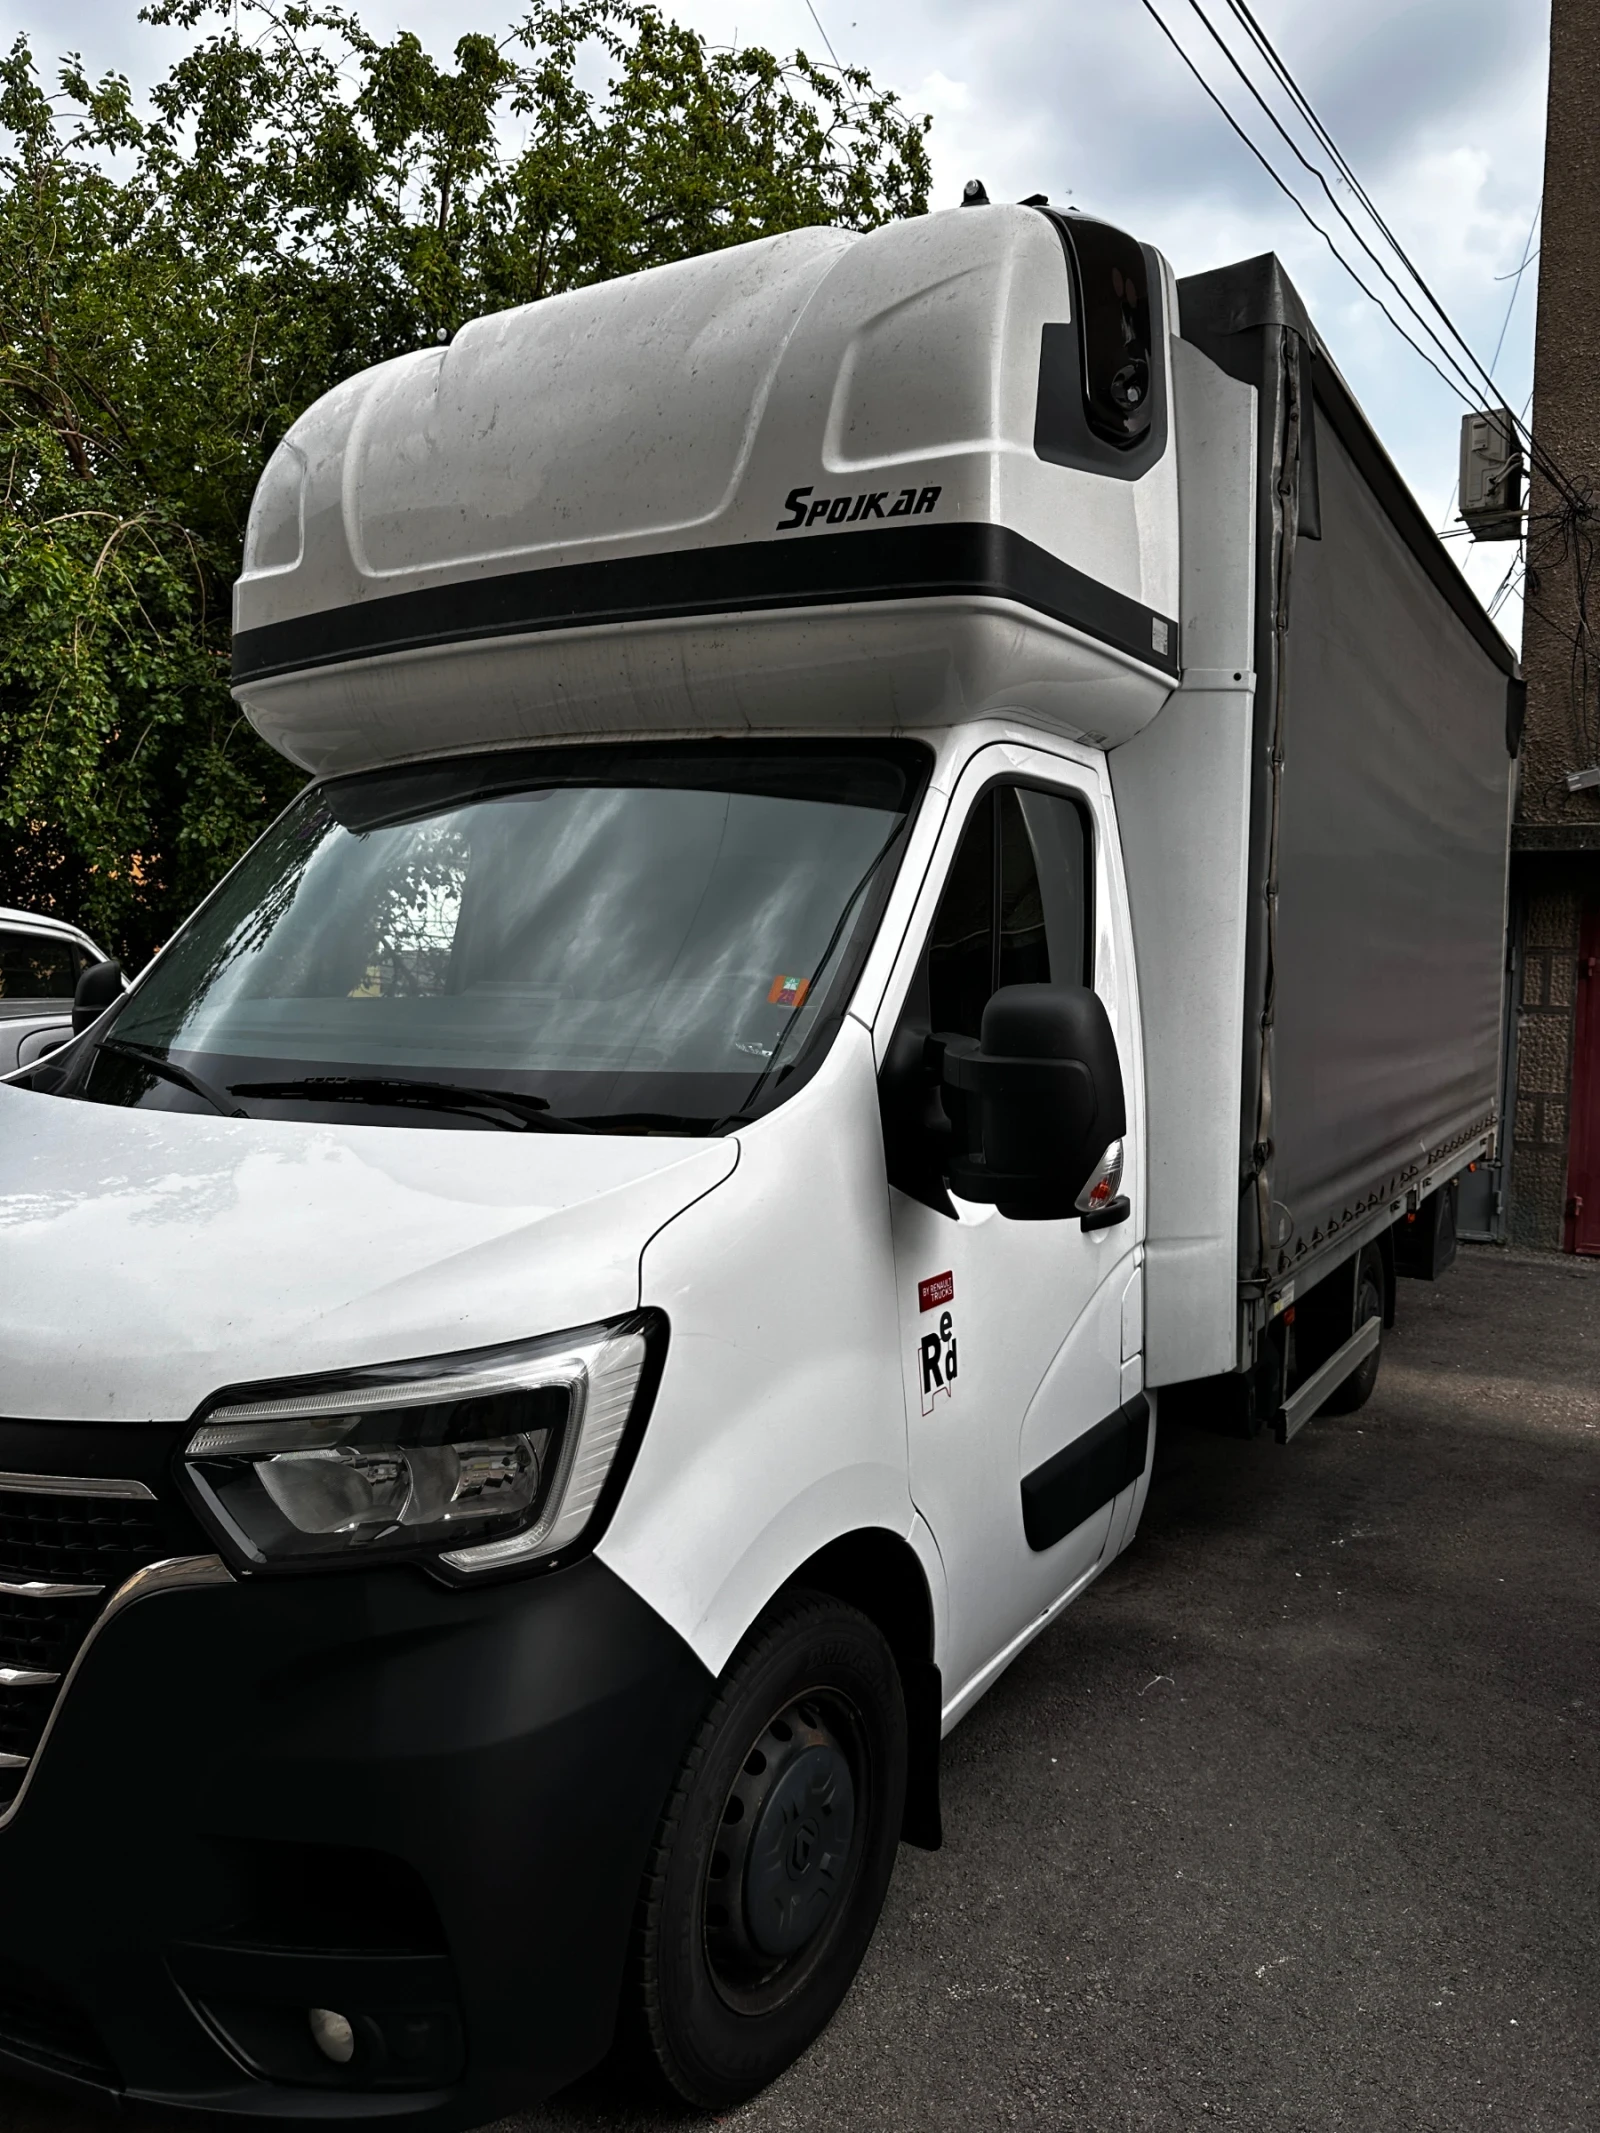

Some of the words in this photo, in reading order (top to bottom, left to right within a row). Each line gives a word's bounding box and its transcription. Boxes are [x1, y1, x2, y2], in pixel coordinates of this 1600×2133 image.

[776, 486, 942, 531] SPOJKAR
[922, 1286, 930, 1297] BY
[930, 1277, 952, 1294] RENAULT
[931, 1285, 953, 1302] TRUCKS
